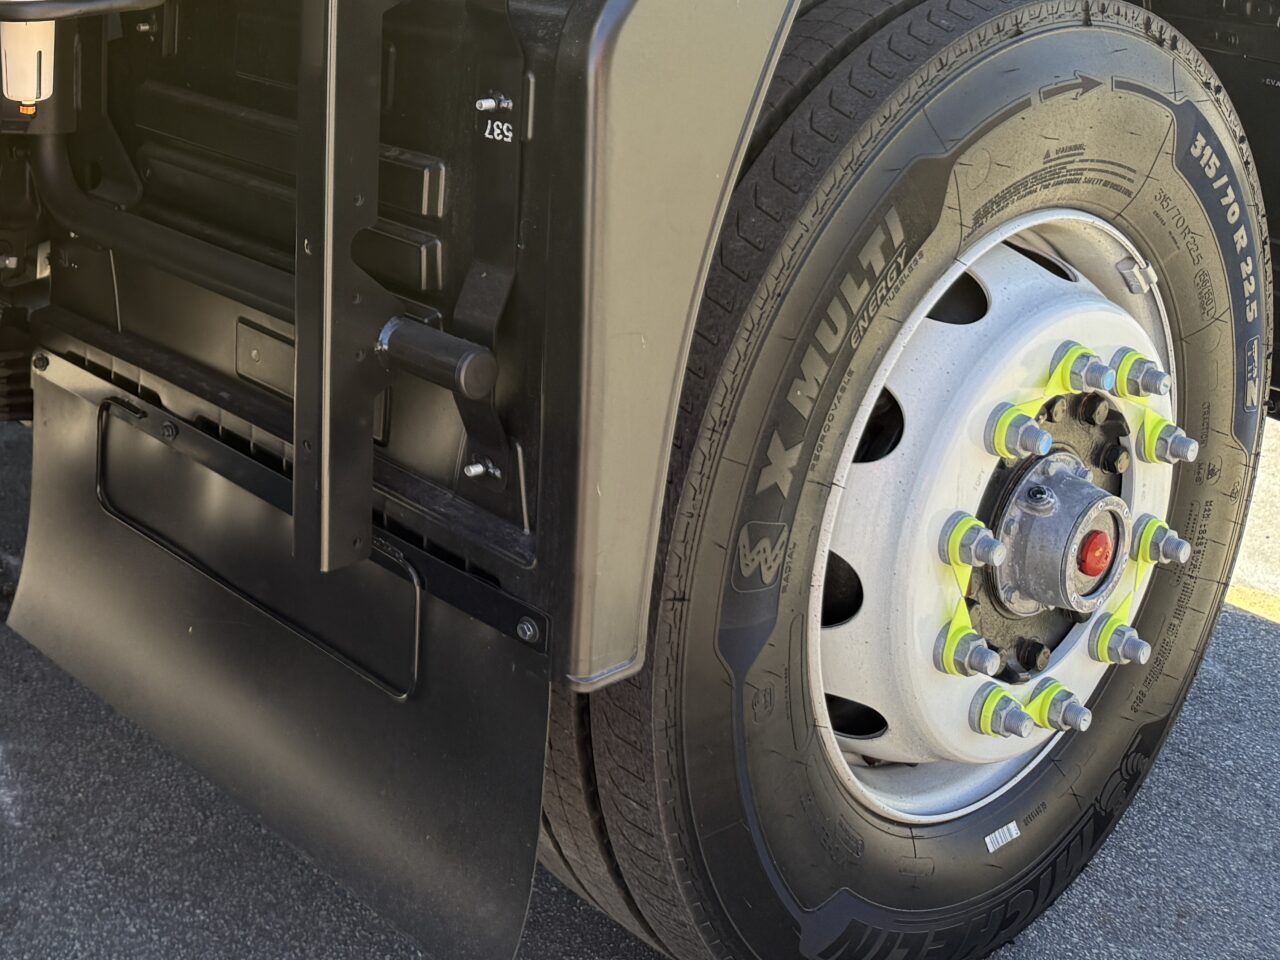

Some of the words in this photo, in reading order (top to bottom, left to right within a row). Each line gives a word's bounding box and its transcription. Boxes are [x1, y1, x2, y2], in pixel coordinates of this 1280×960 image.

[484, 119, 513, 143] 537
[786, 204, 905, 420] MULTI
[849, 242, 908, 349] ENERGY
[883, 249, 925, 308] TUBELESS
[1239, 255, 1258, 323] 22.5
[809, 368, 856, 473] REGROOVABLE
[781, 541, 797, 594] RADIAL
